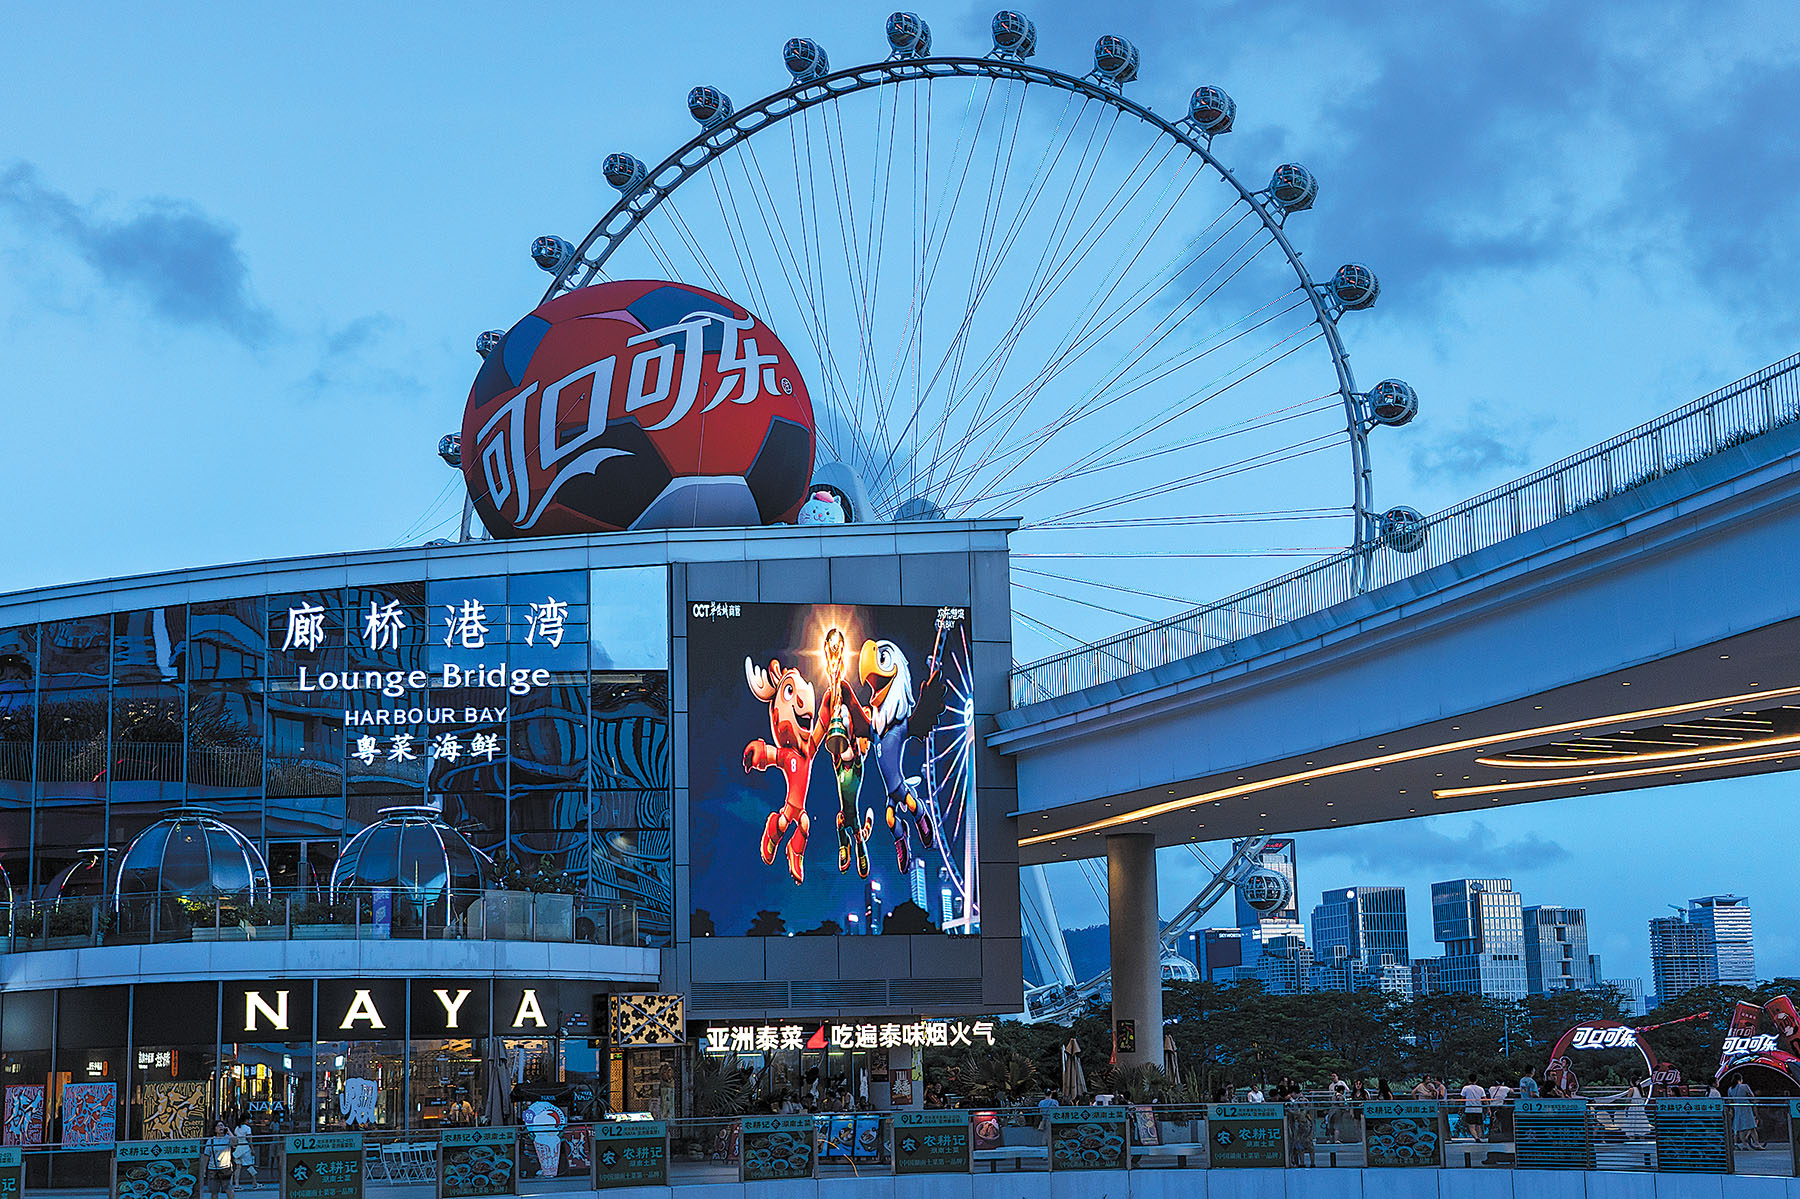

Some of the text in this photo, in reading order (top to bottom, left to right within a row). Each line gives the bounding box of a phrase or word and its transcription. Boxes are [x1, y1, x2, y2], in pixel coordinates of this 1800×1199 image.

[476, 310, 782, 529] 可口可乐
[692, 603, 710, 618] OCT
[281, 595, 569, 653] 廊桥港湾
[298, 662, 551, 698] Lounge Bridge
[344, 706, 509, 727] HARBOUR BAY
[351, 732, 501, 766] 粤菜海鲜
[789, 757, 798, 772] 8
[243, 988, 548, 1032] NAYA
[705, 1020, 997, 1052] 亚洲泰菜 吃遍泰味烟火气
[1572, 1025, 1638, 1051] 可口可乐
[1722, 1033, 1780, 1056] 可口可乐
[247, 1100, 286, 1112] NAYA
[1223, 1107, 1238, 1118] L2
[908, 1114, 923, 1125] L2
[609, 1126, 623, 1136] L2
[1238, 1127, 1282, 1141] 农耕记
[302, 1138, 316, 1150] L2
[923, 1133, 966, 1147] 农耕记
[623, 1146, 664, 1160] 农耕记
[315, 1160, 359, 1175] 农耕记
